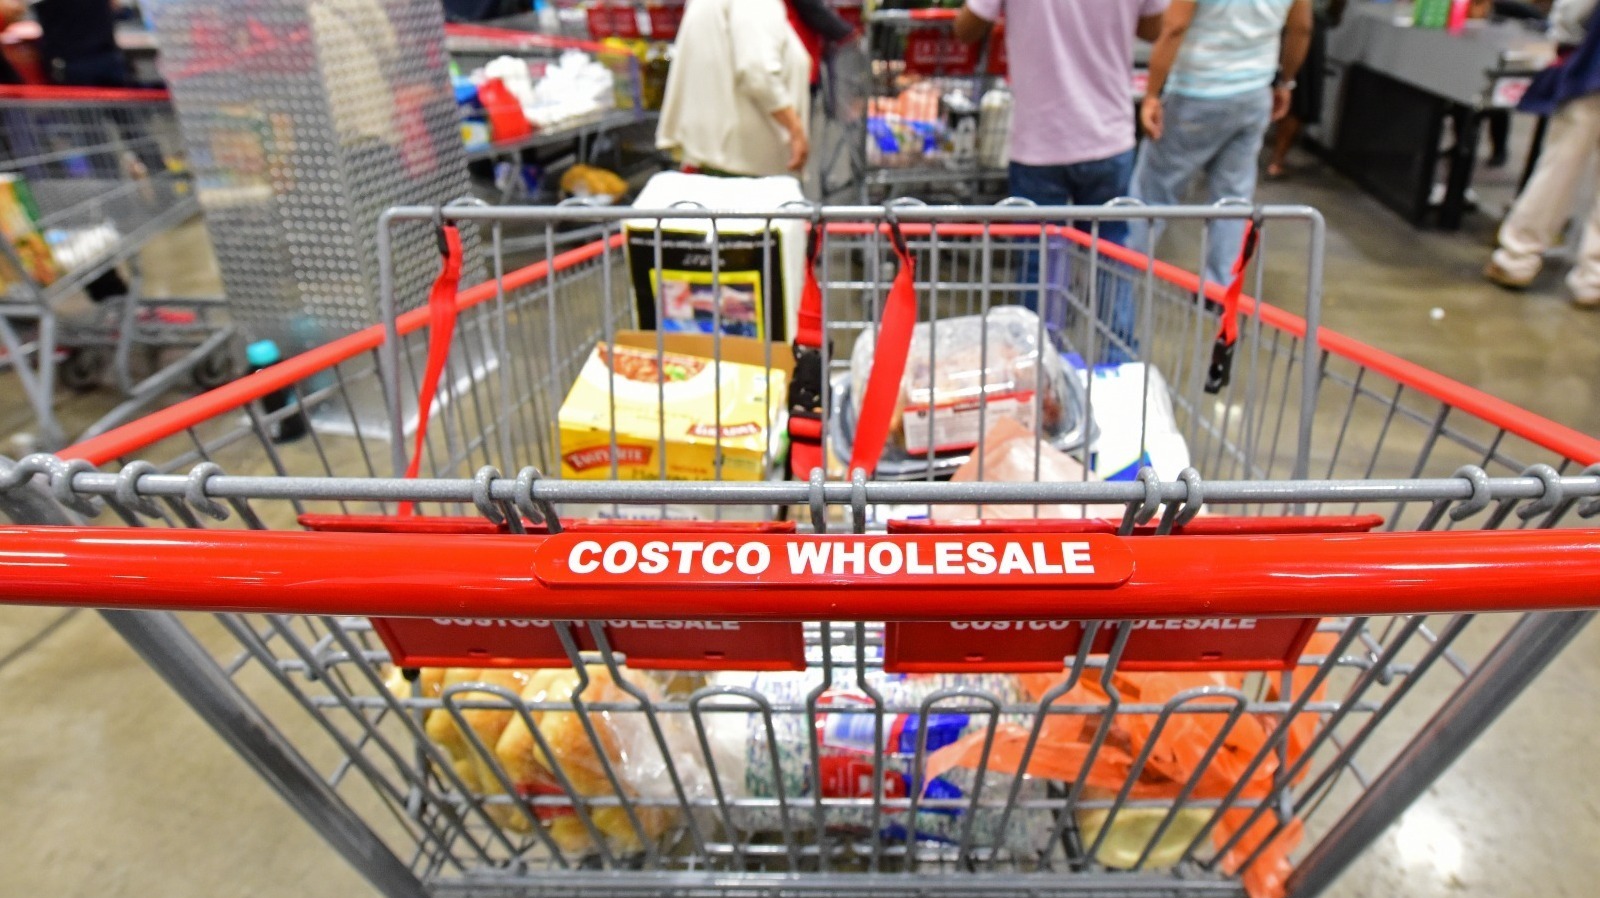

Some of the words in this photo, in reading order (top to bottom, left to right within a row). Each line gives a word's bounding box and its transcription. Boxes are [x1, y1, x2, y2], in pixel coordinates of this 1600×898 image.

[568, 540, 770, 575] COSTCO
[786, 541, 1095, 574] WHOLESALE
[573, 620, 740, 630] OLESALE
